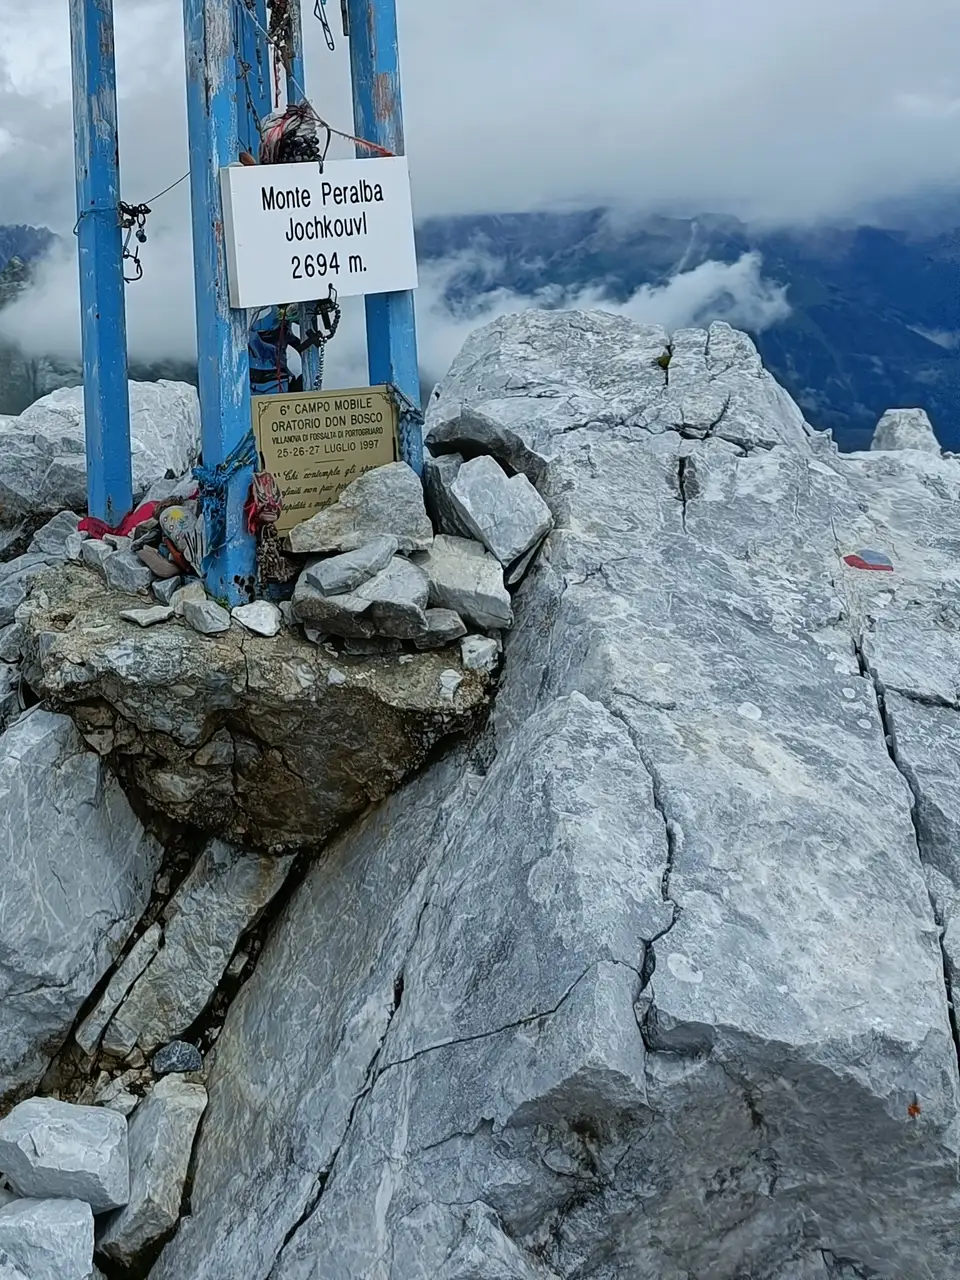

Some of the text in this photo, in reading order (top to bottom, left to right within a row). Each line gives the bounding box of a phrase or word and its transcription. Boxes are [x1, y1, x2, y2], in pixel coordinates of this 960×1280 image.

[261, 179, 384, 211] Monte Peralba
[285, 211, 368, 242] Jochkouvl
[291, 252, 367, 279] 2694 m.
[280, 397, 373, 416] 6° CAMPO MOBILE
[271, 412, 383, 433] ORATORIO DON BOSCO
[271, 426, 384, 445] VILLANOVA DI FOSSALTA DI PORTOGRUARO
[277, 439, 379, 458] 25-26-27 LUGLIO 1997
[303, 467, 341, 480] contempla
[344, 464, 357, 477] gli
[303, 486, 318, 494] non
